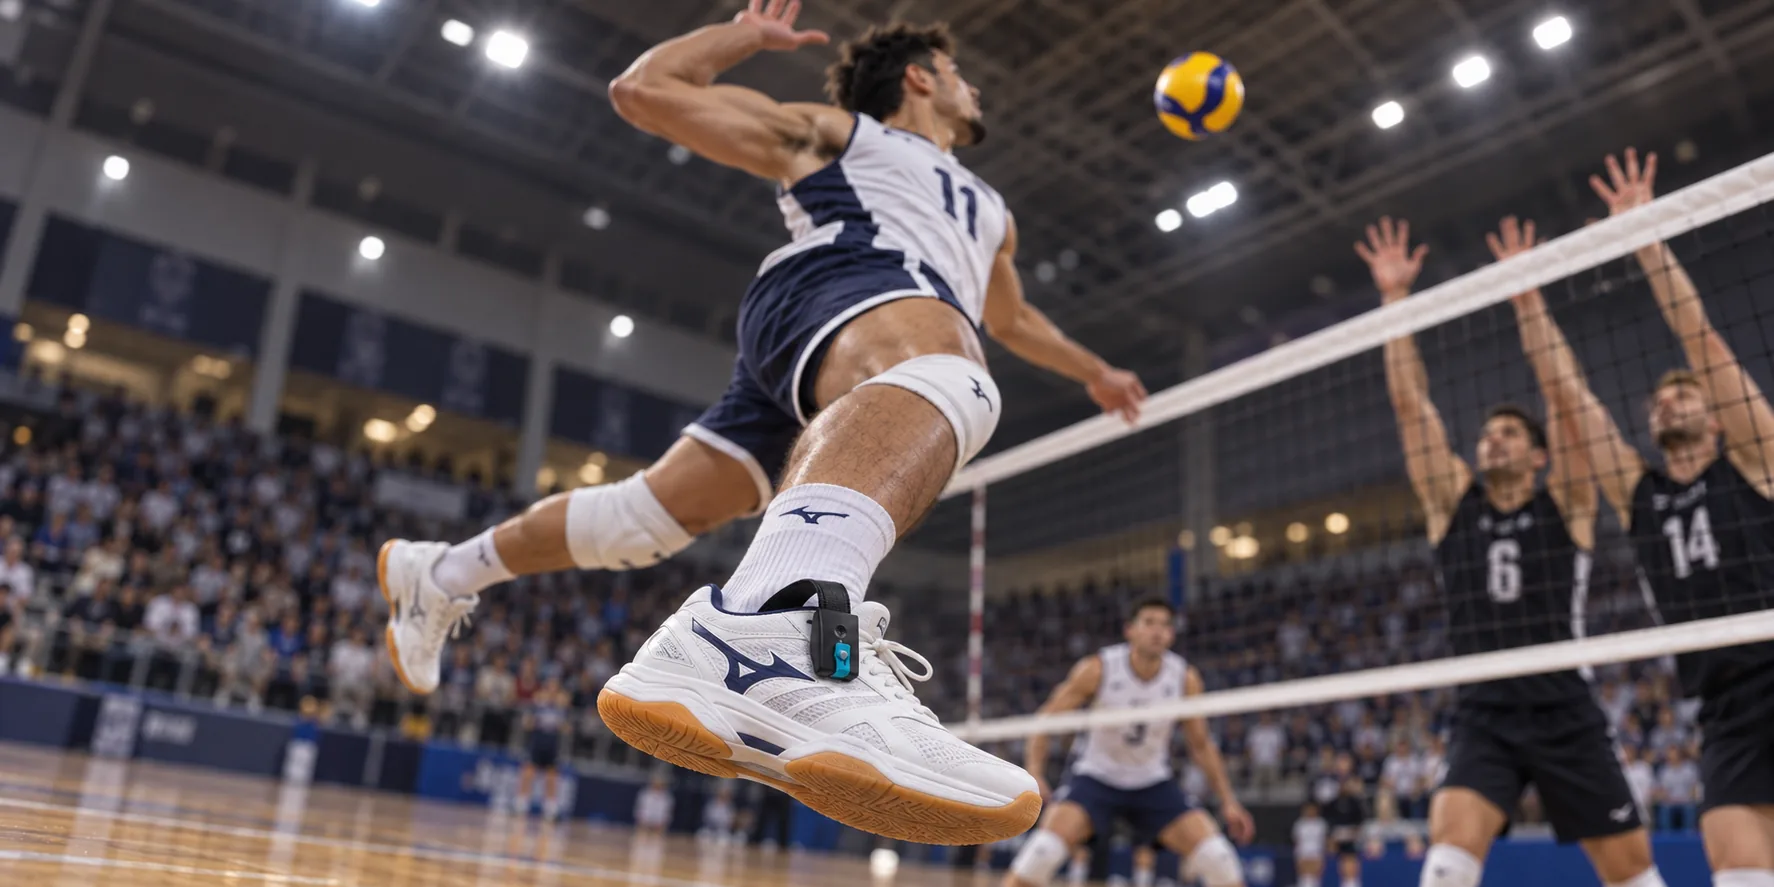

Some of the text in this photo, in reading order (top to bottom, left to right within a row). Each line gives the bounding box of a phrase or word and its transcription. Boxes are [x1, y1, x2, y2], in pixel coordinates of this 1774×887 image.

[934, 166, 977, 241] 11
[1487, 539, 1521, 603] 6
[1662, 506, 1720, 579] 14
